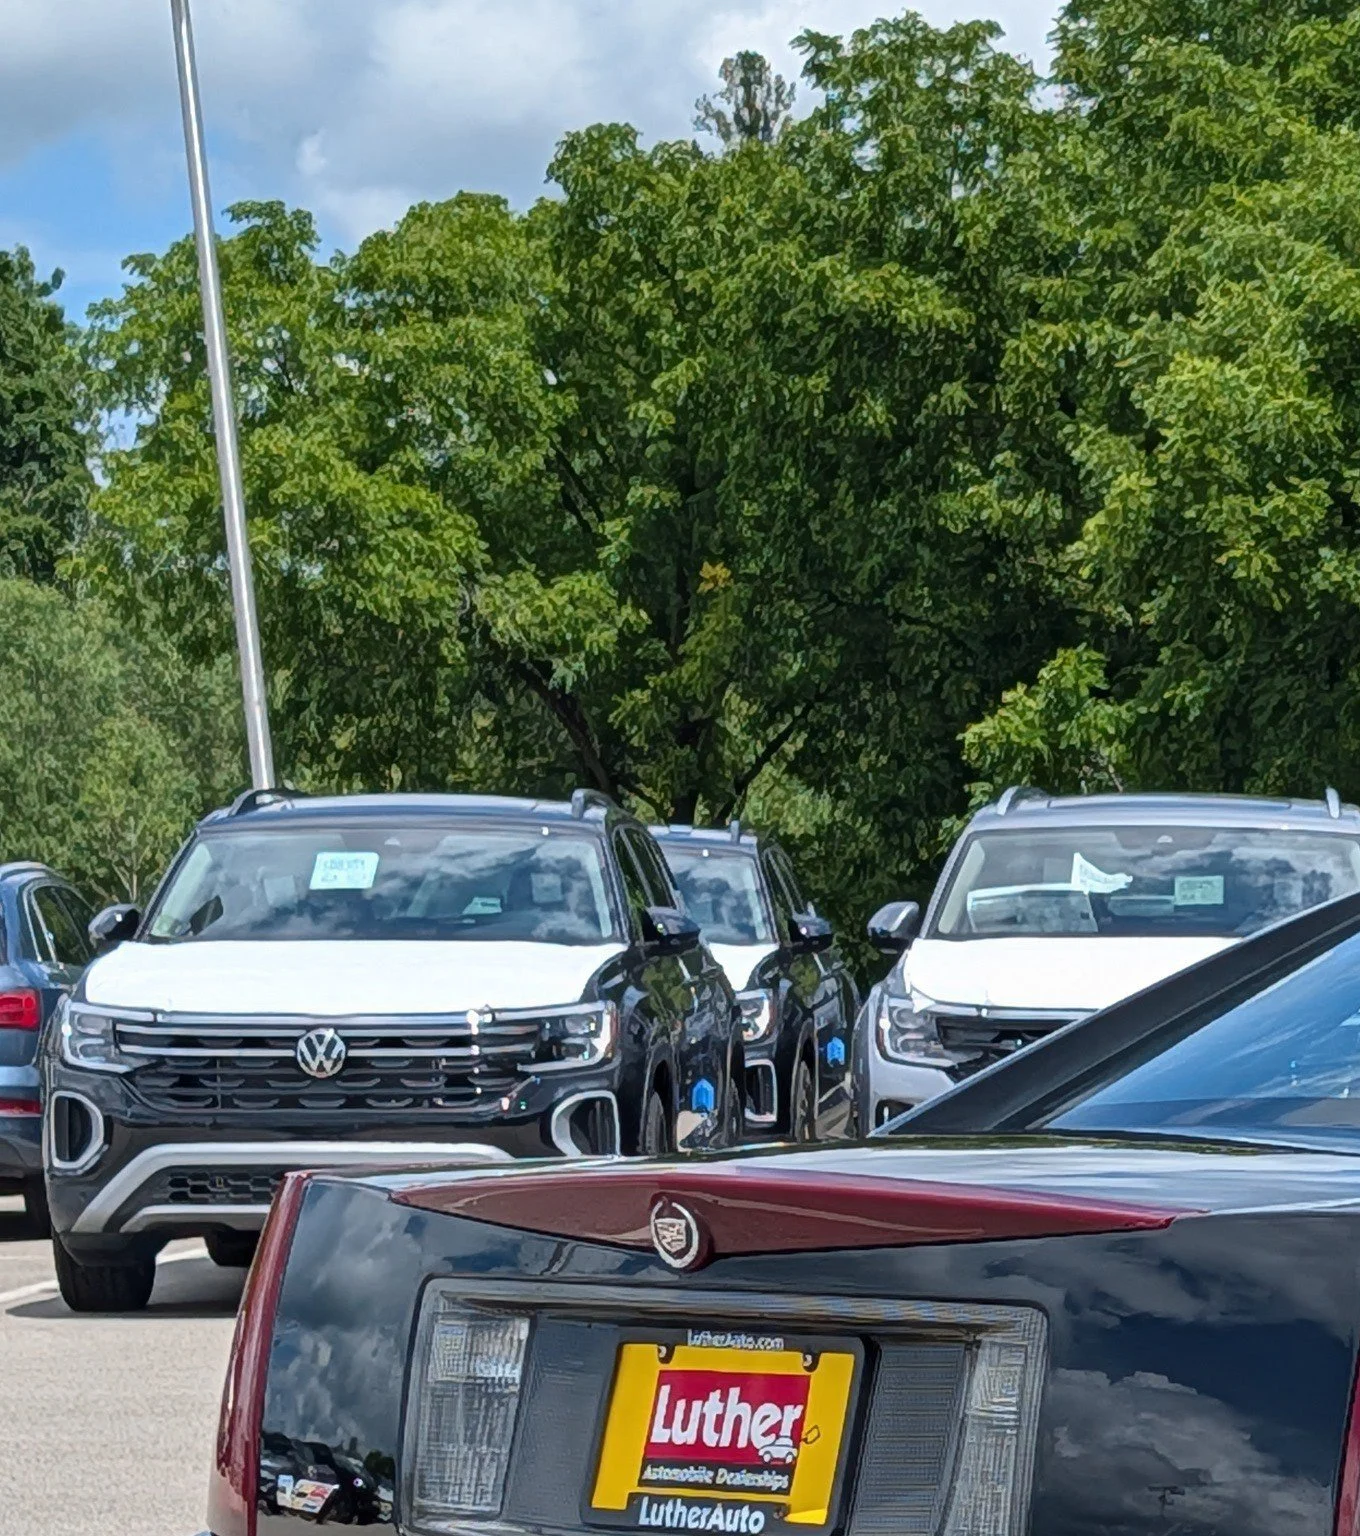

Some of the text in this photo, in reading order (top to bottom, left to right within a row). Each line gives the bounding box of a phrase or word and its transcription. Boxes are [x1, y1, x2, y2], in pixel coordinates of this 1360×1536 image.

[650, 1384, 804, 1449] Luther
[641, 1464, 789, 1490] Automobile Dealerships
[637, 1496, 766, 1535] LutherAuto
